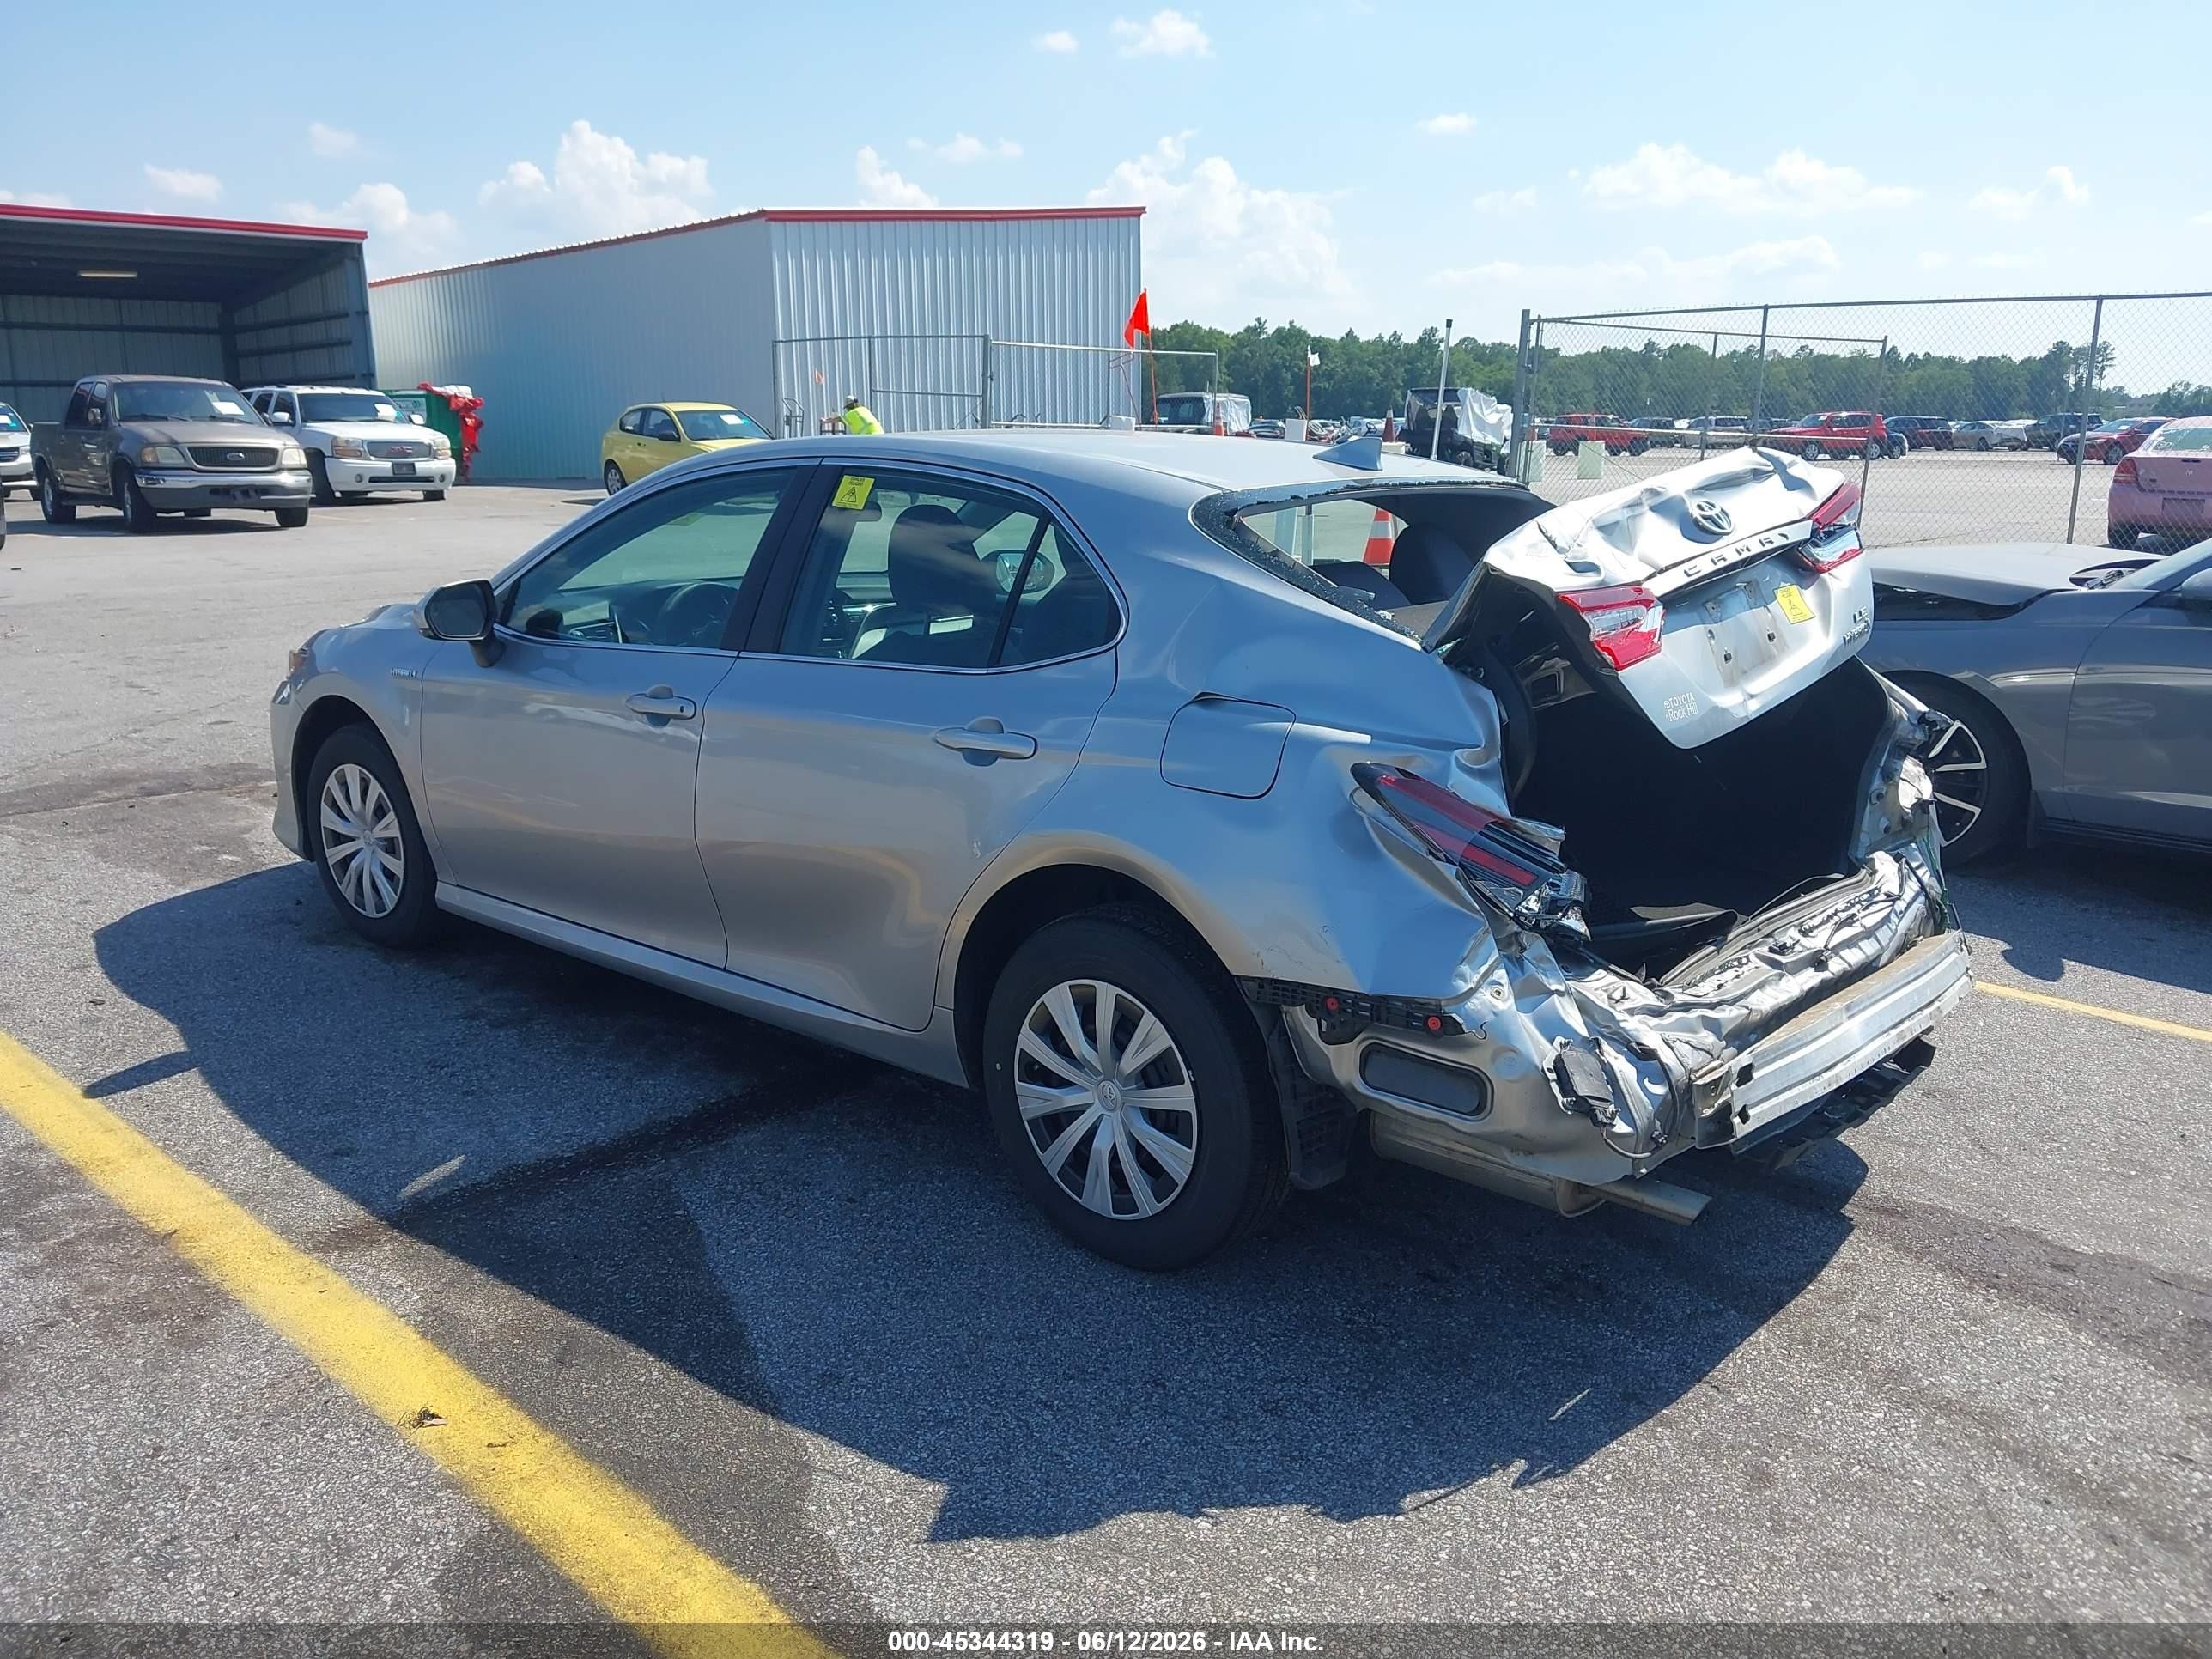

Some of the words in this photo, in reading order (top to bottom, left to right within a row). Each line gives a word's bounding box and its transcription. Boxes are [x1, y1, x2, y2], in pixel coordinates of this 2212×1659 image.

[1684, 532, 1790, 578] CAMRY
[1853, 605, 1868, 624] LE
[1843, 617, 1870, 647] HYBRID
[1669, 692, 1695, 708] TOYOTA
[1668, 706, 1689, 722] Rock
[1686, 702, 1698, 716] Hill
